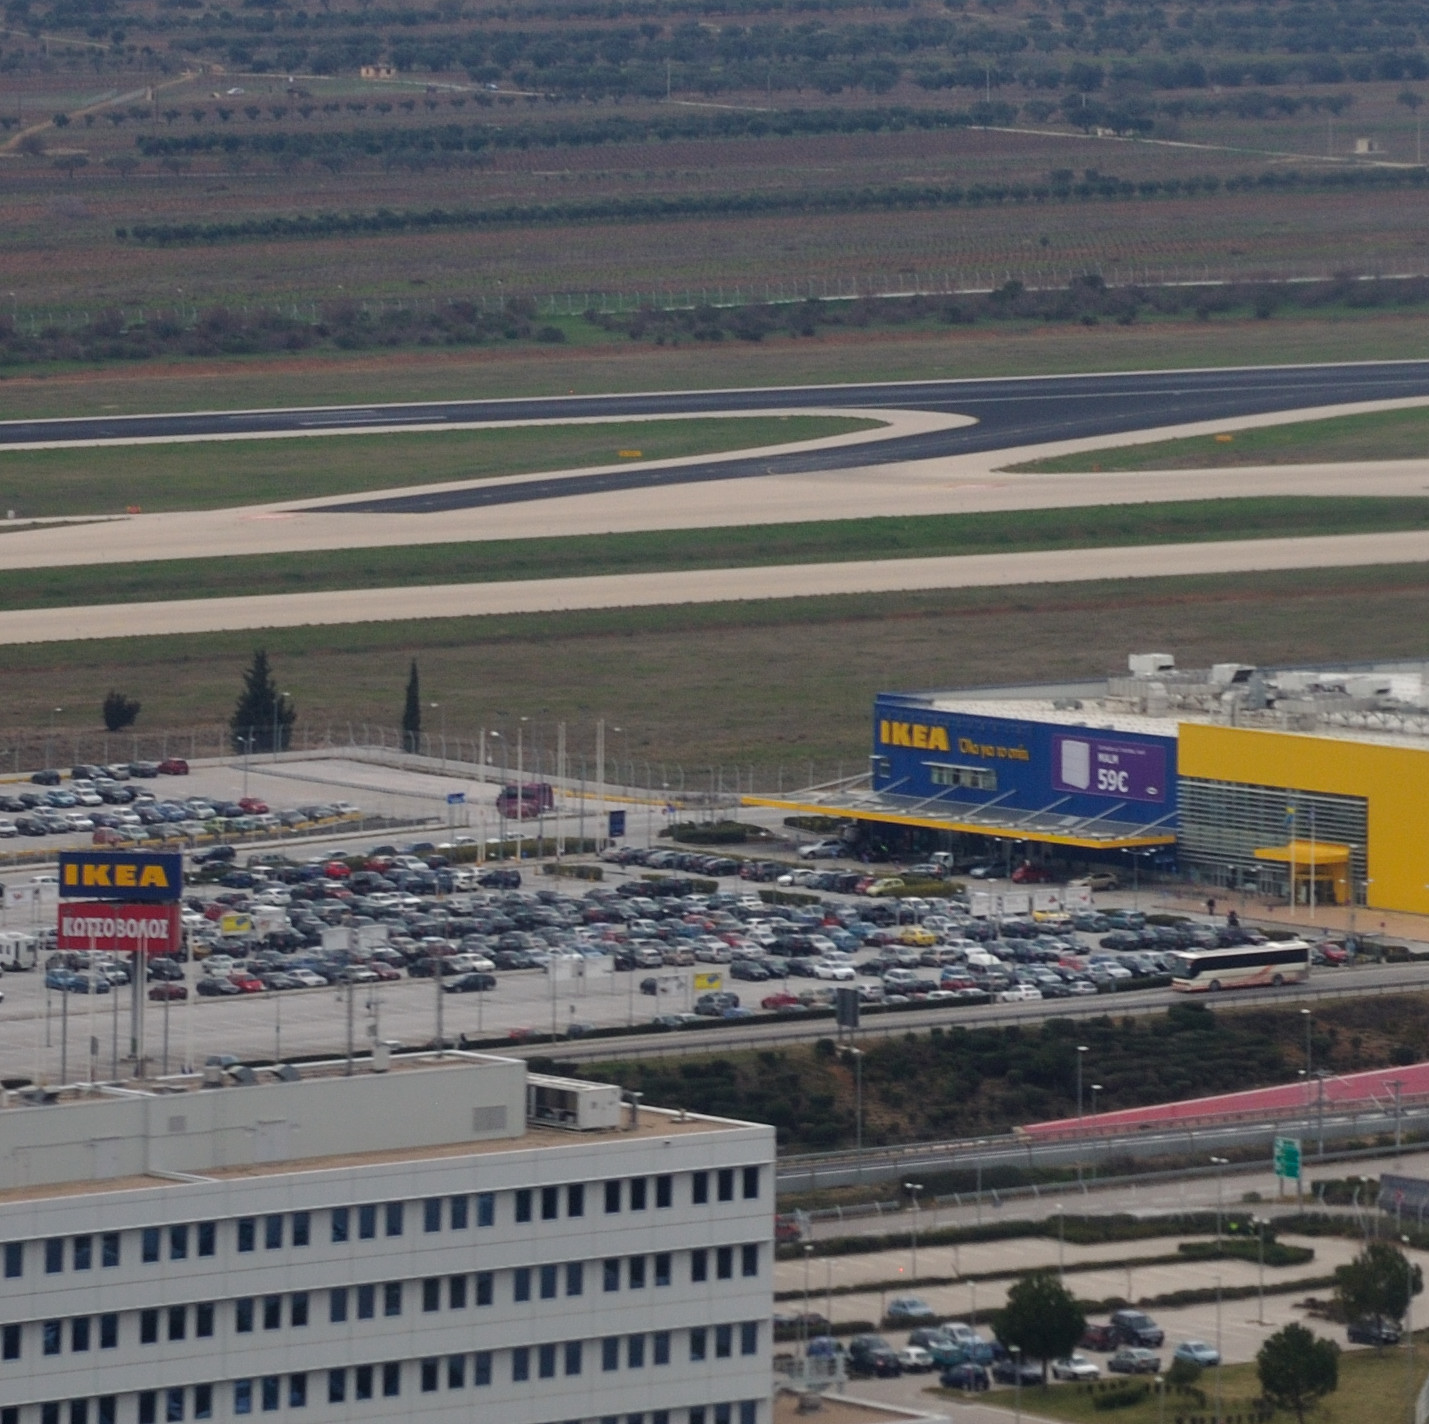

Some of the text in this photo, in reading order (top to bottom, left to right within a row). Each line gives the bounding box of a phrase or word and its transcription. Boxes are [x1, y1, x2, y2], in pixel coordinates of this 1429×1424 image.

[880, 720, 950, 752] IKEA
[1098, 769, 1129, 793] 59€
[65, 863, 169, 888] IKEA
